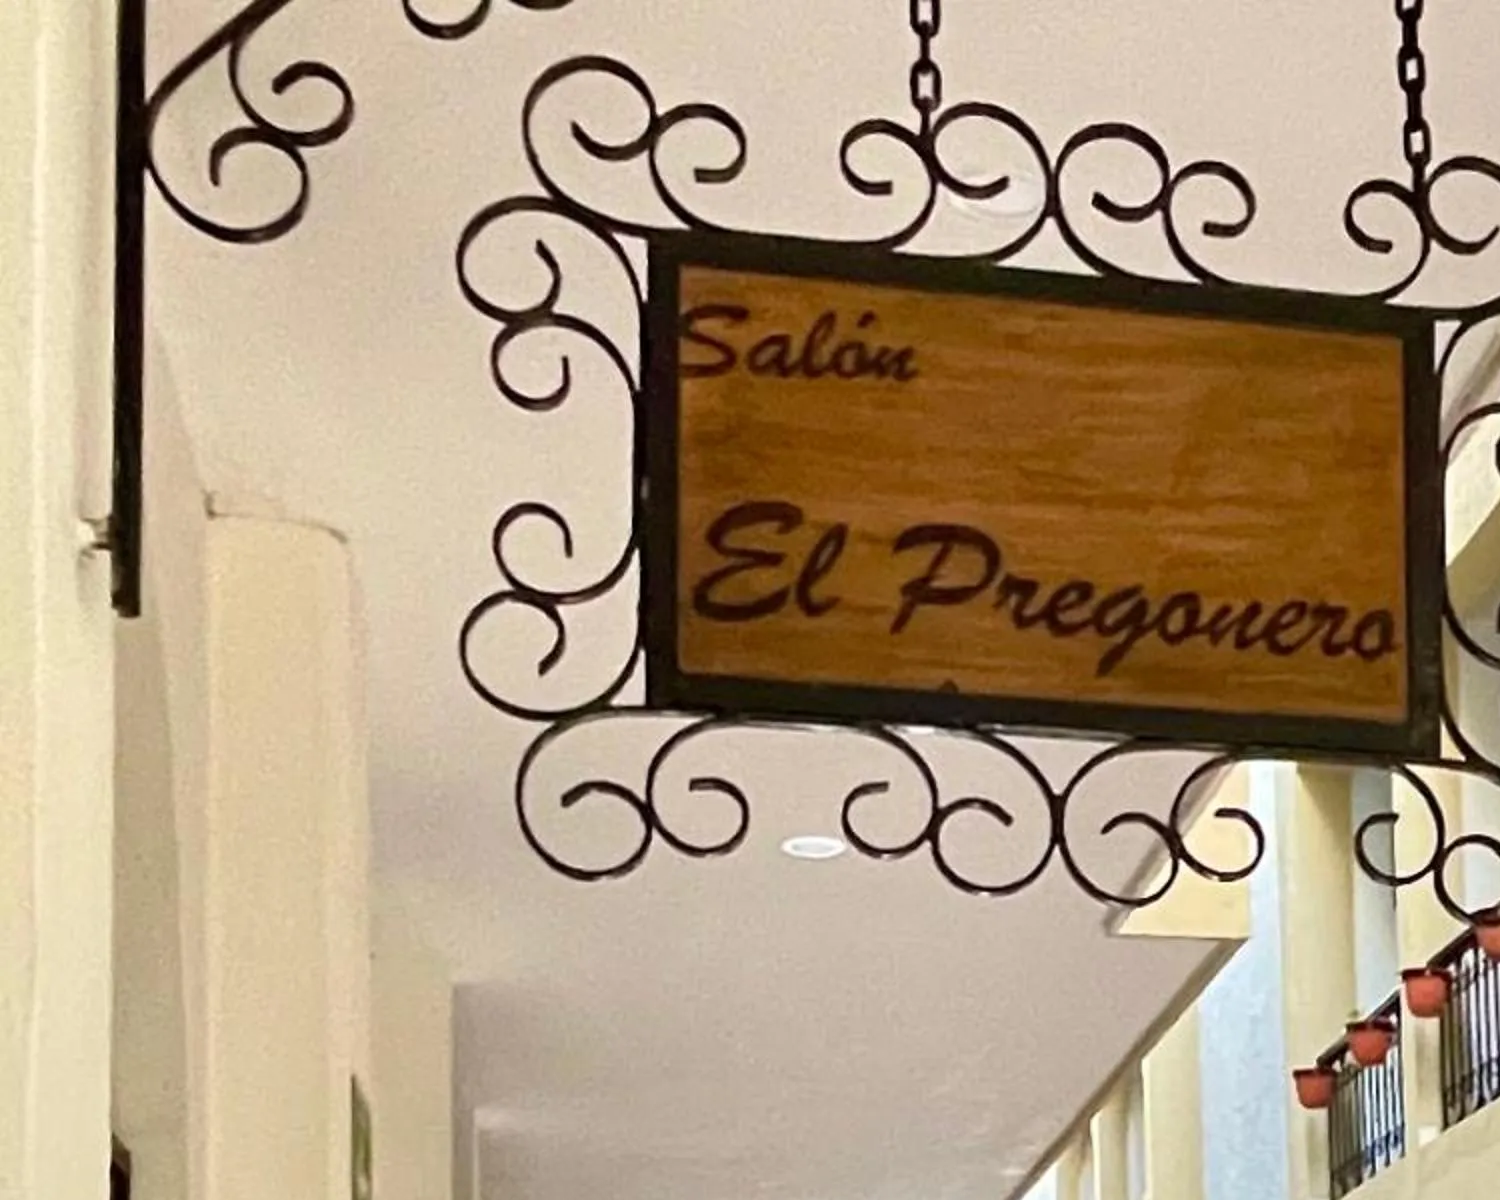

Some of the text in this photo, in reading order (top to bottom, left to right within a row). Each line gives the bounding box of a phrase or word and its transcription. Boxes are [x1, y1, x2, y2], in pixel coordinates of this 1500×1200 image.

[679, 305, 920, 382] Salón
[692, 501, 1400, 677] El Pregonero
